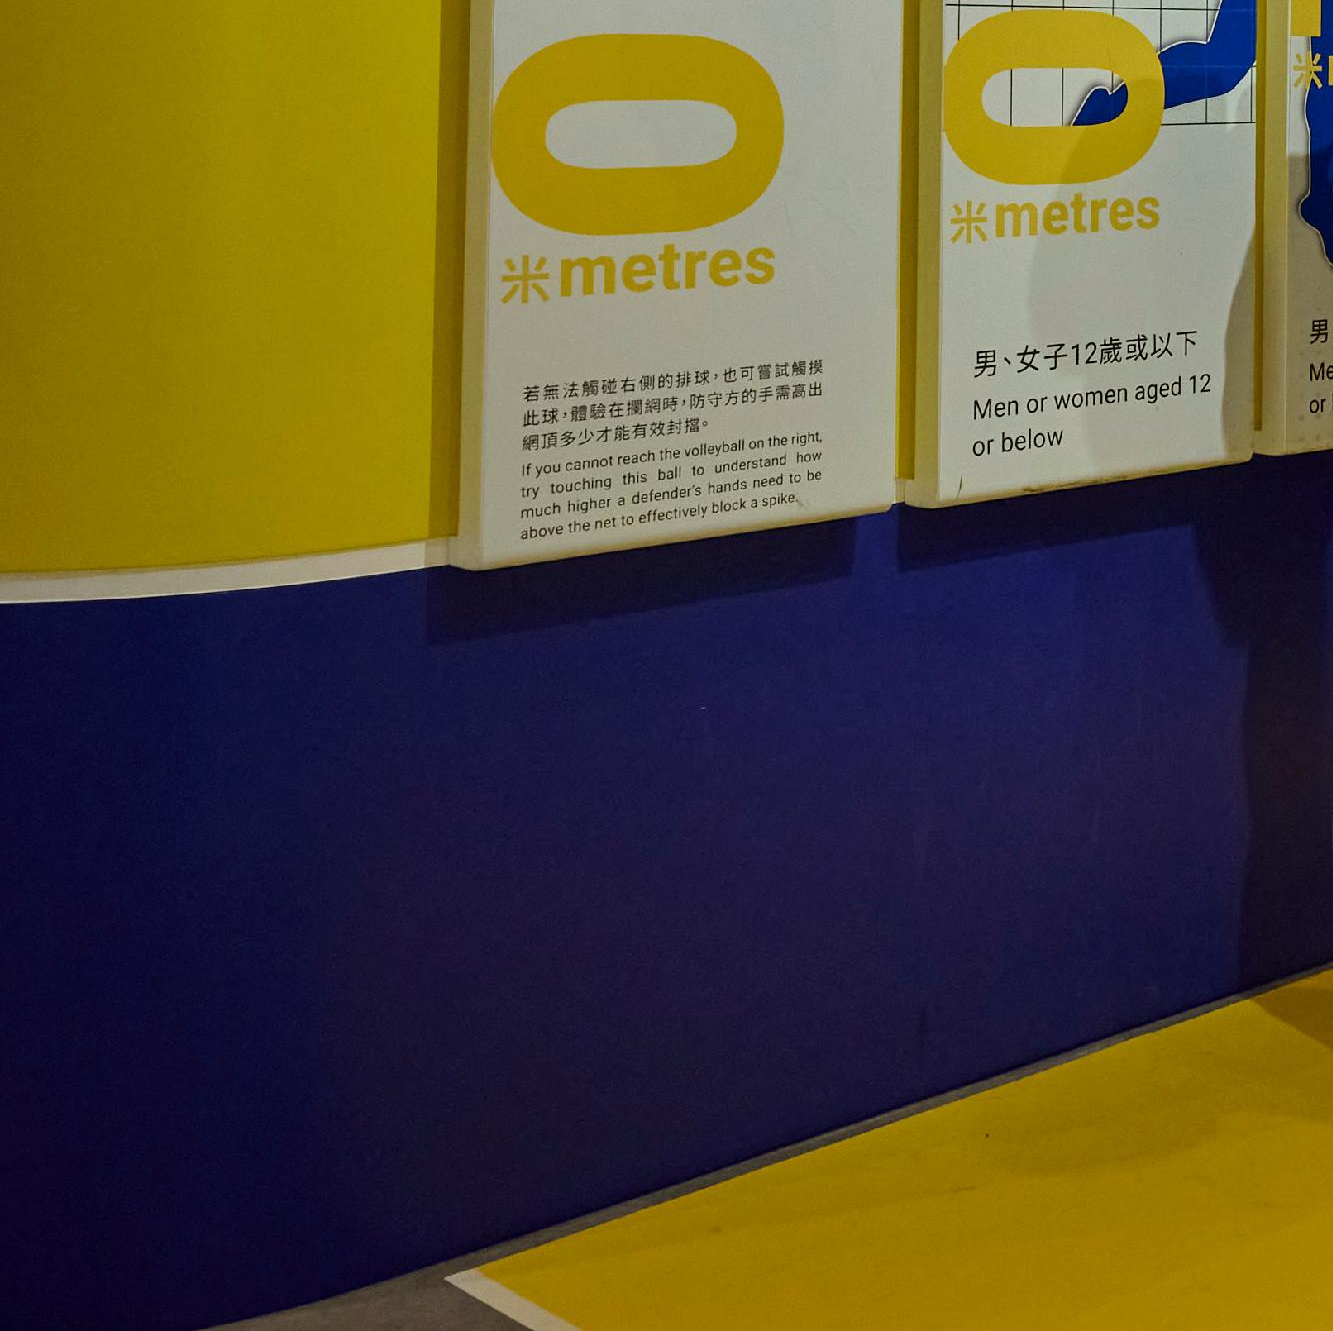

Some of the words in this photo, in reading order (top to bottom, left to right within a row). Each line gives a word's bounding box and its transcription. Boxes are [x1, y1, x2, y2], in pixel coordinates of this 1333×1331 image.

[1292, 53, 1324, 90] 米
[950, 201, 989, 246] 米
[995, 193, 1161, 238] metres
[500, 254, 551, 305] 米
[560, 243, 776, 298] metres
[973, 330, 1197, 378] 男、女子12歲或以下
[973, 398, 1018, 420] Men
[1026, 395, 1048, 413] or
[1053, 387, 1127, 410] women
[1134, 374, 1181, 404] aged
[1189, 373, 1210, 394] 12
[1309, 398, 1326, 413] or
[522, 462, 532, 476] If
[535, 463, 560, 478] you
[565, 455, 613, 471] cannot
[617, 449, 655, 465] reach
[659, 447, 680, 461] the
[684, 438, 744, 457] volleyball
[748, 439, 764, 450] on
[767, 435, 787, 447] the
[791, 431, 822, 446] right,
[972, 438, 994, 456] or
[1001, 427, 1063, 452] below
[520, 486, 540, 500] try
[550, 477, 611, 494] touching
[622, 471, 647, 485] this
[657, 465, 681, 480] ball
[691, 465, 704, 476] to
[714, 453, 786, 474] understand
[796, 451, 822, 471] how
[520, 498, 561, 518] much
[567, 497, 612, 514] higher
[617, 496, 625, 506] a
[631, 484, 701, 504] defender's
[708, 478, 747, 494] hands
[752, 472, 783, 488] need
[789, 473, 801, 484] to
[806, 469, 821, 481] be
[520, 525, 564, 540] above
[567, 520, 590, 533] the
[594, 516, 616, 530] net
[620, 515, 634, 526] to
[638, 503, 708, 523] effectively
[711, 497, 746, 513] block
[750, 498, 757, 508] a
[761, 491, 799, 508] spike.
